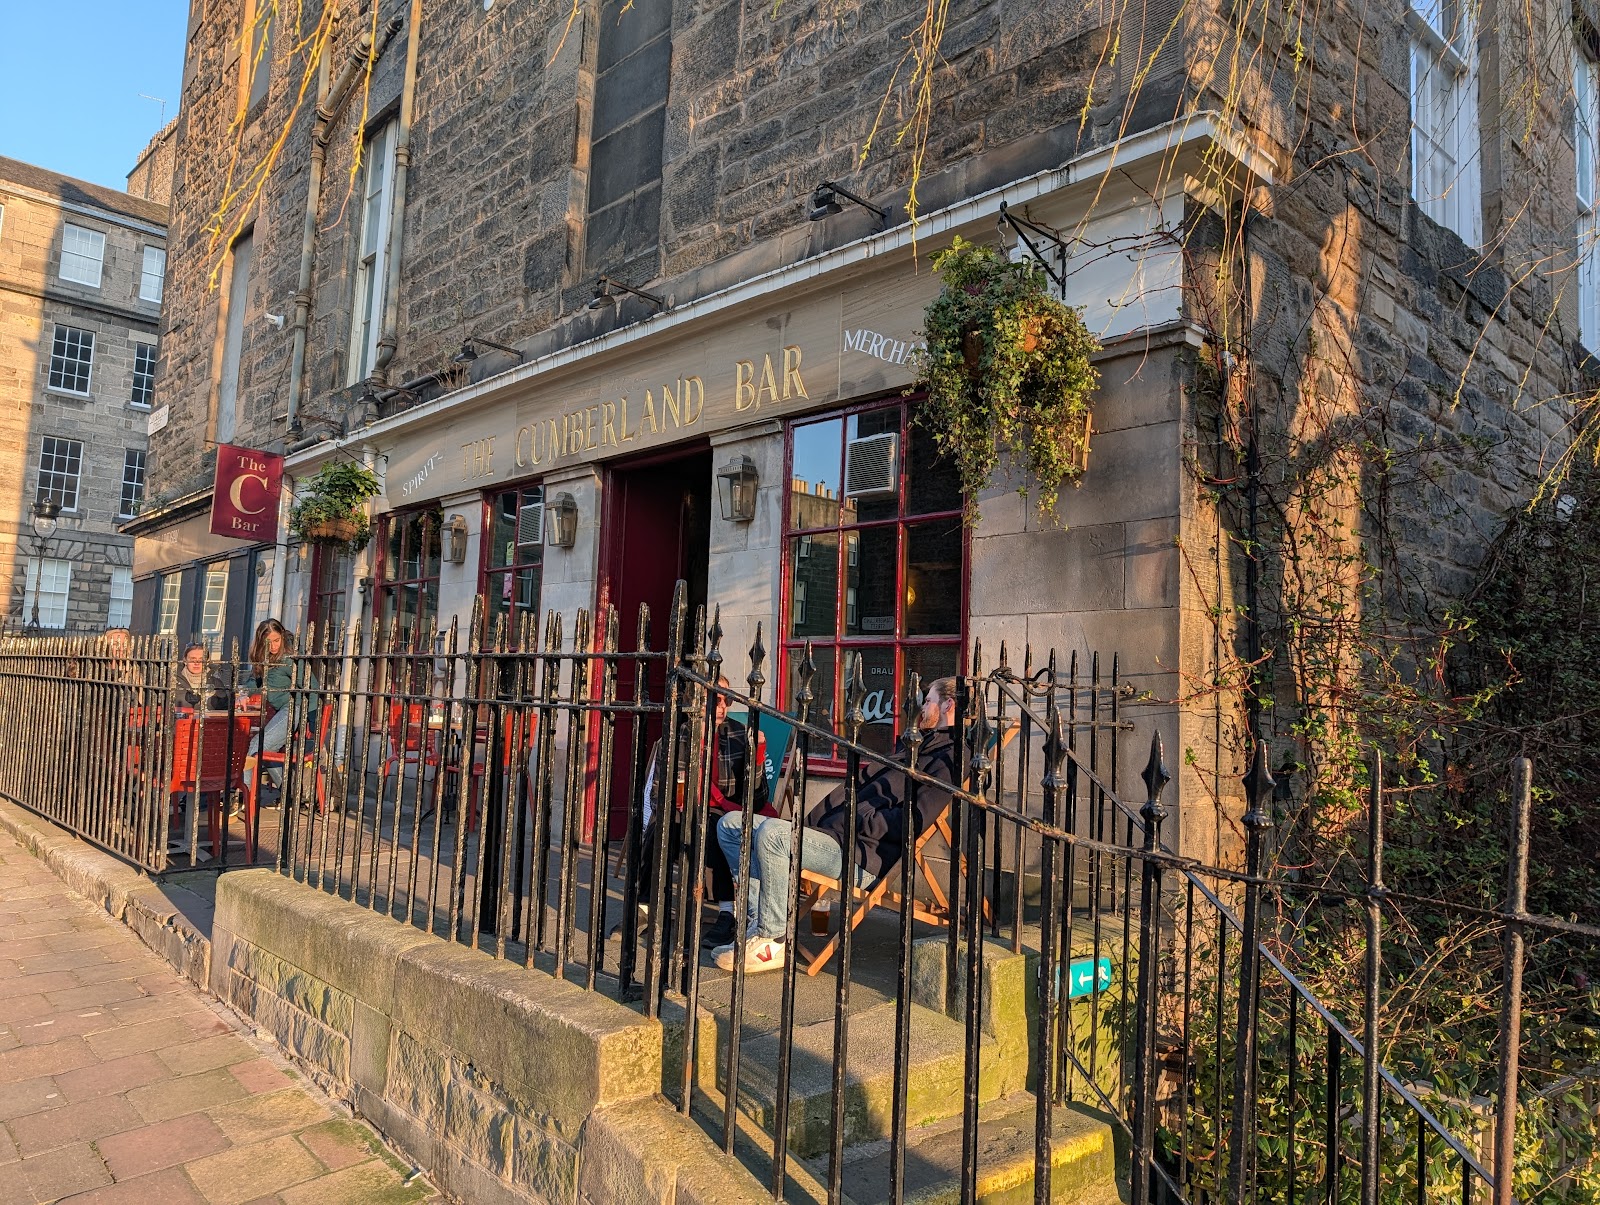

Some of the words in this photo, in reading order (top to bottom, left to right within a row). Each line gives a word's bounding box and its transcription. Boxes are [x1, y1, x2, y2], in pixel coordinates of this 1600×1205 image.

[459, 435, 496, 483] THE
[515, 373, 704, 468] CUMBERLAND
[735, 345, 810, 415] BAR
[236, 455, 267, 473] The
[229, 473, 269, 515] C
[231, 516, 260, 532] Bar
[871, 667, 912, 676] DRAUT
